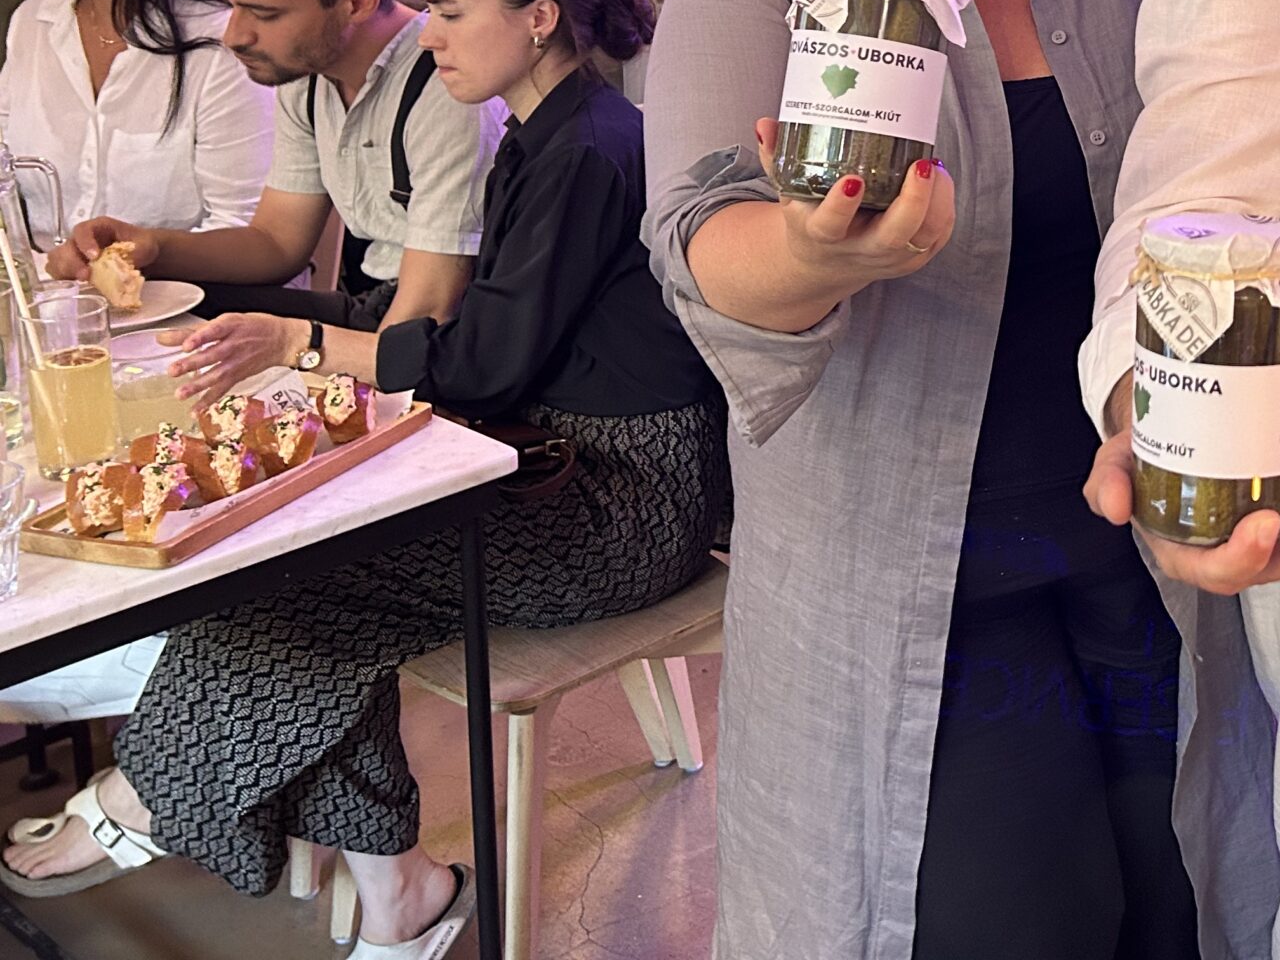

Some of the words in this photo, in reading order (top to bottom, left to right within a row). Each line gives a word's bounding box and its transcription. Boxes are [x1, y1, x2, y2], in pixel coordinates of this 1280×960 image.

[790, 38, 849, 58] OVÁSZOS
[857, 46, 926, 73] UBORKA
[1149, 365, 1223, 396] UBORKA
